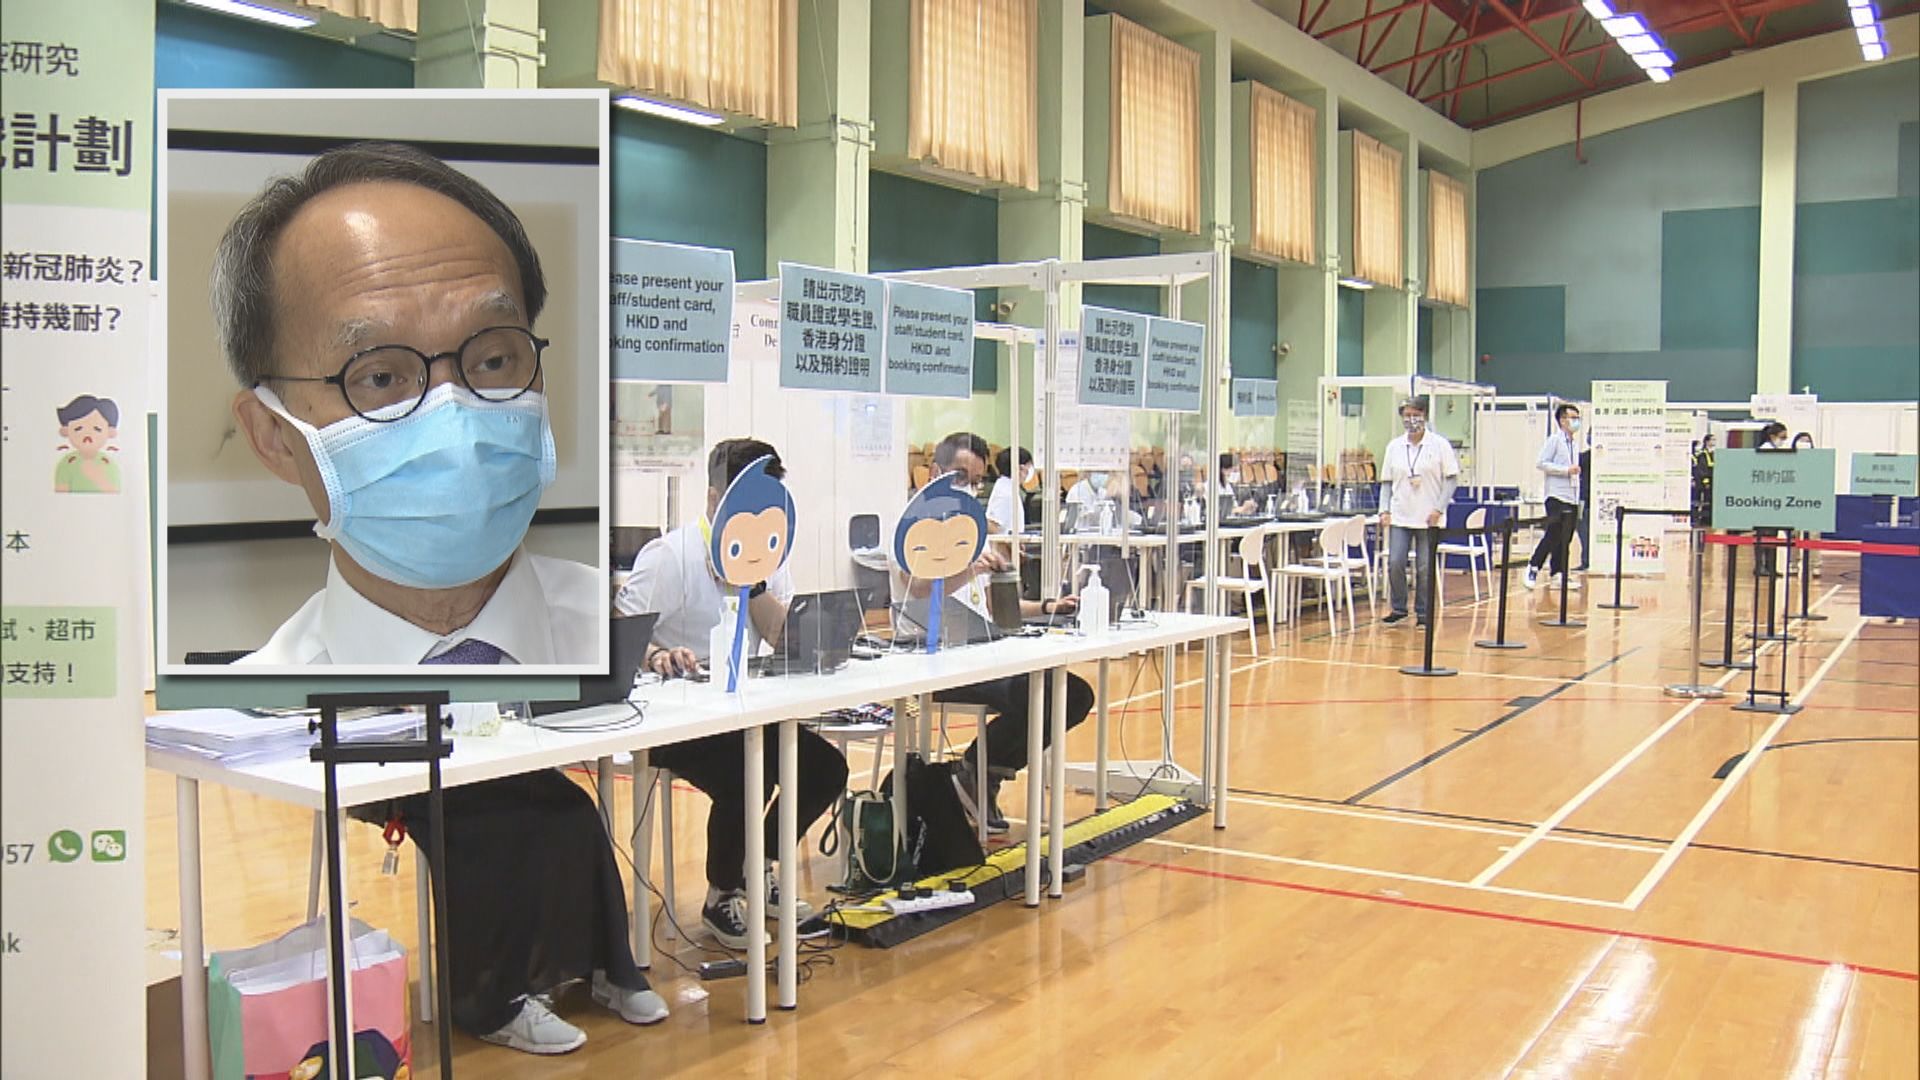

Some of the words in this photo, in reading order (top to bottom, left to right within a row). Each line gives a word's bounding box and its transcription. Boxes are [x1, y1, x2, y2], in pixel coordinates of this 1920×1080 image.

[1, 112, 132, 176] 計劃
[642, 275, 691, 289] present
[695, 279, 724, 293] your
[803, 278, 866, 305] 請出示您的
[684, 299, 716, 315] card,
[893, 305, 919, 319] Please
[921, 311, 951, 322] present
[626, 314, 660, 330] HKID
[663, 318, 688, 331] and
[609, 335, 641, 353] king
[645, 339, 725, 353] confirmation
[802, 327, 865, 352] 香港身分證
[911, 342, 933, 355] HKID
[795, 352, 870, 377] 以及預約證明
[888, 359, 920, 374] booking
[1752, 469, 1796, 484] 預約區
[1725, 496, 1781, 510] Booking
[1786, 496, 1822, 509] Zone
[1, 661, 73, 685] 支持！
